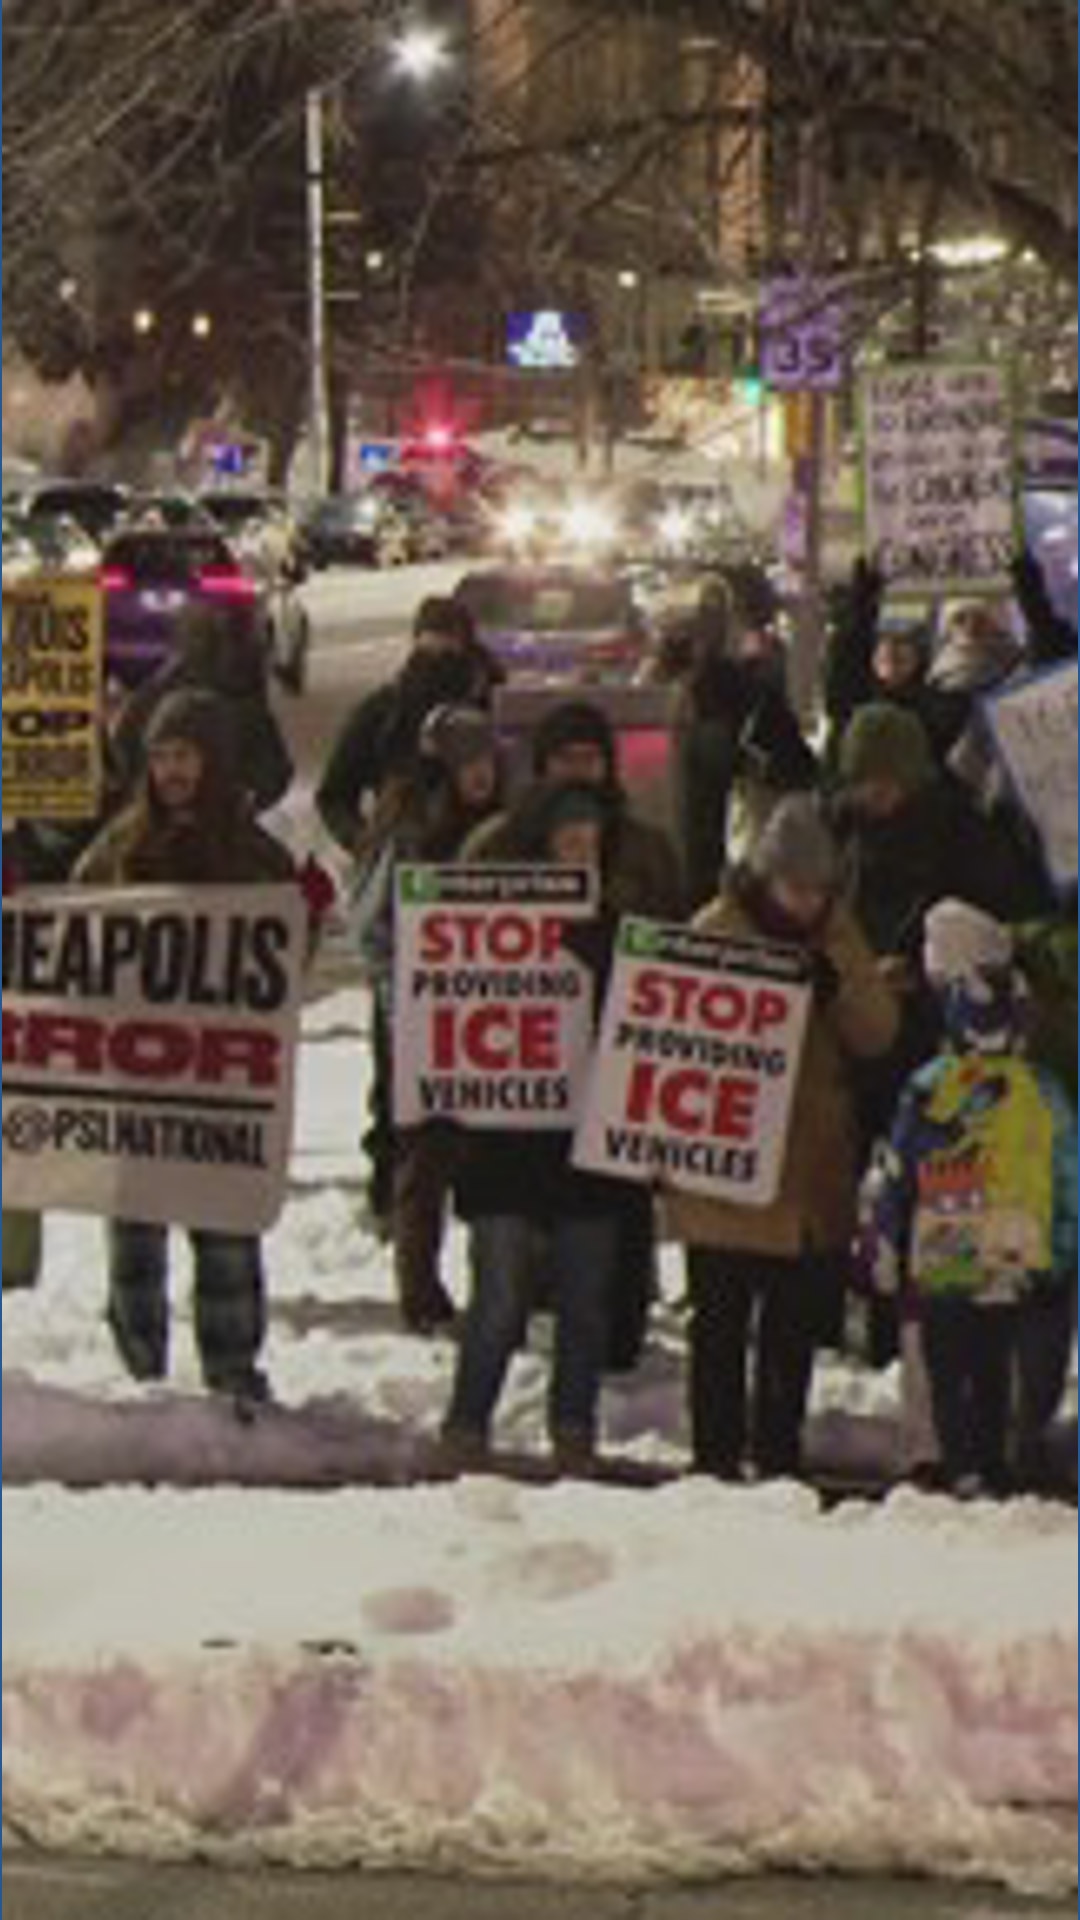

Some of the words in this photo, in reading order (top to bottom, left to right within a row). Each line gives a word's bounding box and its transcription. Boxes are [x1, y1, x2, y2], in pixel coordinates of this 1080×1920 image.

[775, 337, 834, 374] 35
[2, 709, 90, 738] OP
[412, 970, 581, 998] PROVIDING
[632, 968, 788, 1035] STOP
[2, 1010, 281, 1088] ROR
[429, 1005, 560, 1071] ICE
[616, 1022, 786, 1077] PROVIDING
[418, 1076, 569, 1111] VEHICLES
[626, 1061, 760, 1139] ICE
[606, 1126, 759, 1182] VEHICLES
